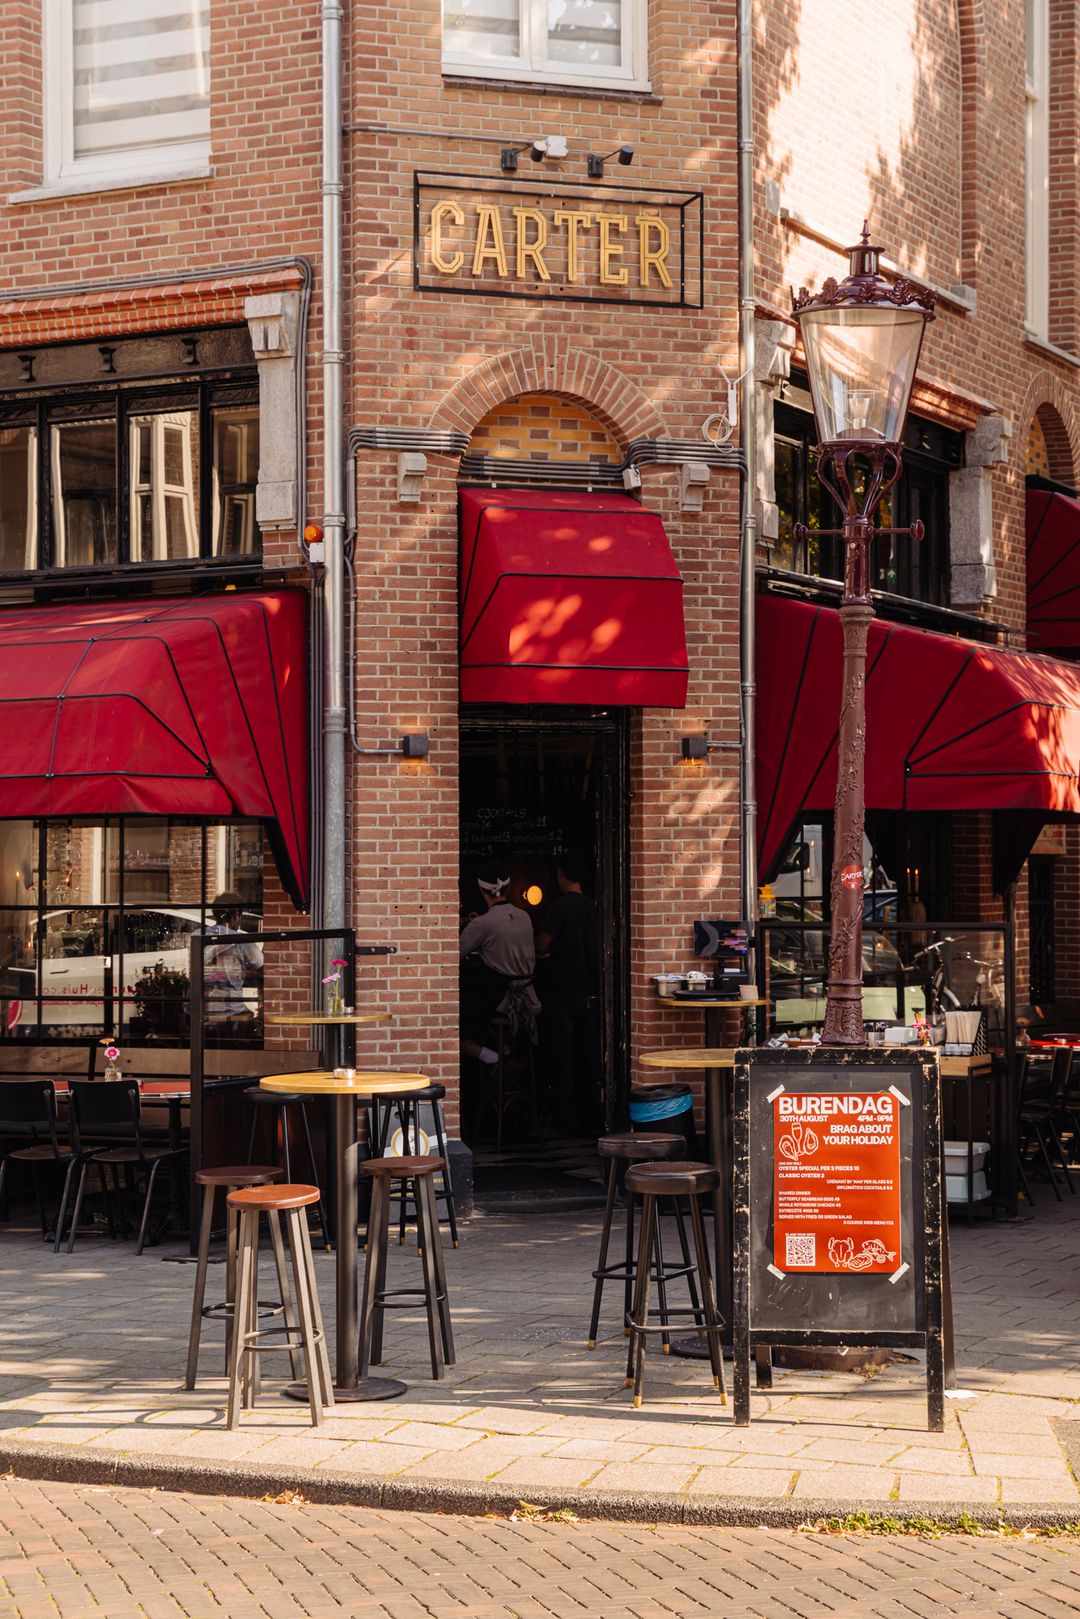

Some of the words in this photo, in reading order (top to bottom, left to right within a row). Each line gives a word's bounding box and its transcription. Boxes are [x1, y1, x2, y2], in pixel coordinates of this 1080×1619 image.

[431, 200, 672, 287] CARTER
[779, 1096, 892, 1115] BURENDAG
[830, 1124, 858, 1133] BRAG
[858, 1124, 892, 1133] ABOUT
[823, 1136, 851, 1144] YOUR
[851, 1136, 893, 1144] HOLIDAY
